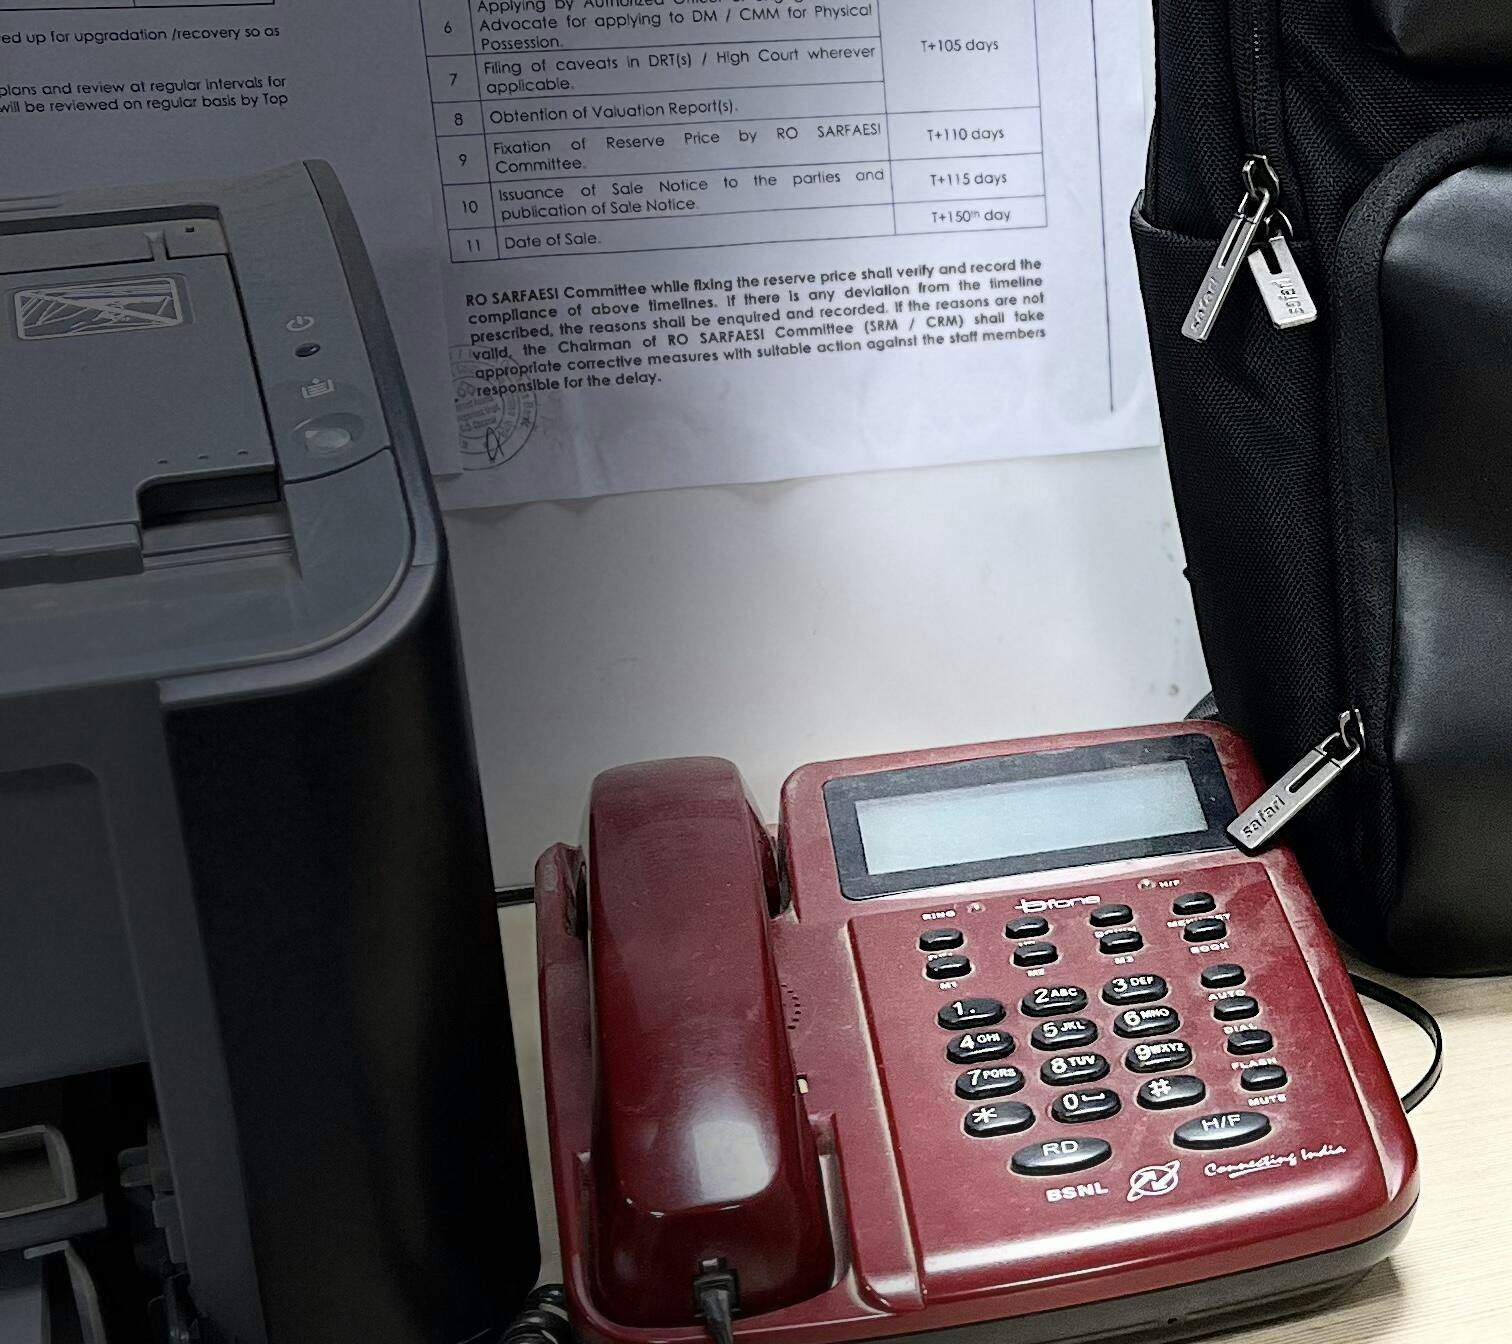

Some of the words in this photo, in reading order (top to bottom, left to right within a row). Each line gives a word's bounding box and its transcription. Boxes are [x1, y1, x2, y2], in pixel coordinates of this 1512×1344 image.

[443, 21, 453, 34] 6
[921, 39, 962, 52] T+105
[965, 39, 999, 52] days
[449, 72, 458, 86] 7
[454, 112, 464, 127] 8
[927, 127, 967, 142] T+110
[971, 127, 1004, 142] days
[458, 153, 468, 166] 9
[930, 172, 970, 187] T+115
[974, 172, 1007, 187] days
[462, 200, 479, 214] 10
[984, 208, 1011, 222] day
[467, 239, 481, 251] 11
[504, 235, 541, 250] Date
[546, 233, 561, 247] of
[465, 293, 488, 307] RO
[491, 287, 559, 305] SARFAESI
[563, 283, 647, 299] Committee
[650, 280, 690, 293] while
[693, 278, 733, 292] fixing
[736, 276, 760, 289] the
[763, 274, 816, 286] reserve
[820, 270, 857, 285] price
[861, 267, 893, 280] shall
[896, 264, 934, 278] verify
[939, 262, 967, 275] and
[970, 259, 1016, 273] record
[1020, 258, 1042, 270] the
[1242, 794, 1286, 838] safari
[921, 909, 957, 921] RING
[1189, 942, 1230, 954] BOOK
[1207, 989, 1247, 1002] AUTO
[1223, 1023, 1258, 1035] DIAL
[1247, 1093, 1288, 1108] MUTE
[1201, 1113, 1241, 1132] H/F
[1041, 1140, 1079, 1157] RD
[1203, 1151, 1298, 1179] Connecting
[1300, 1144, 1347, 1161] India
[1045, 1182, 1109, 1203] BSNL
